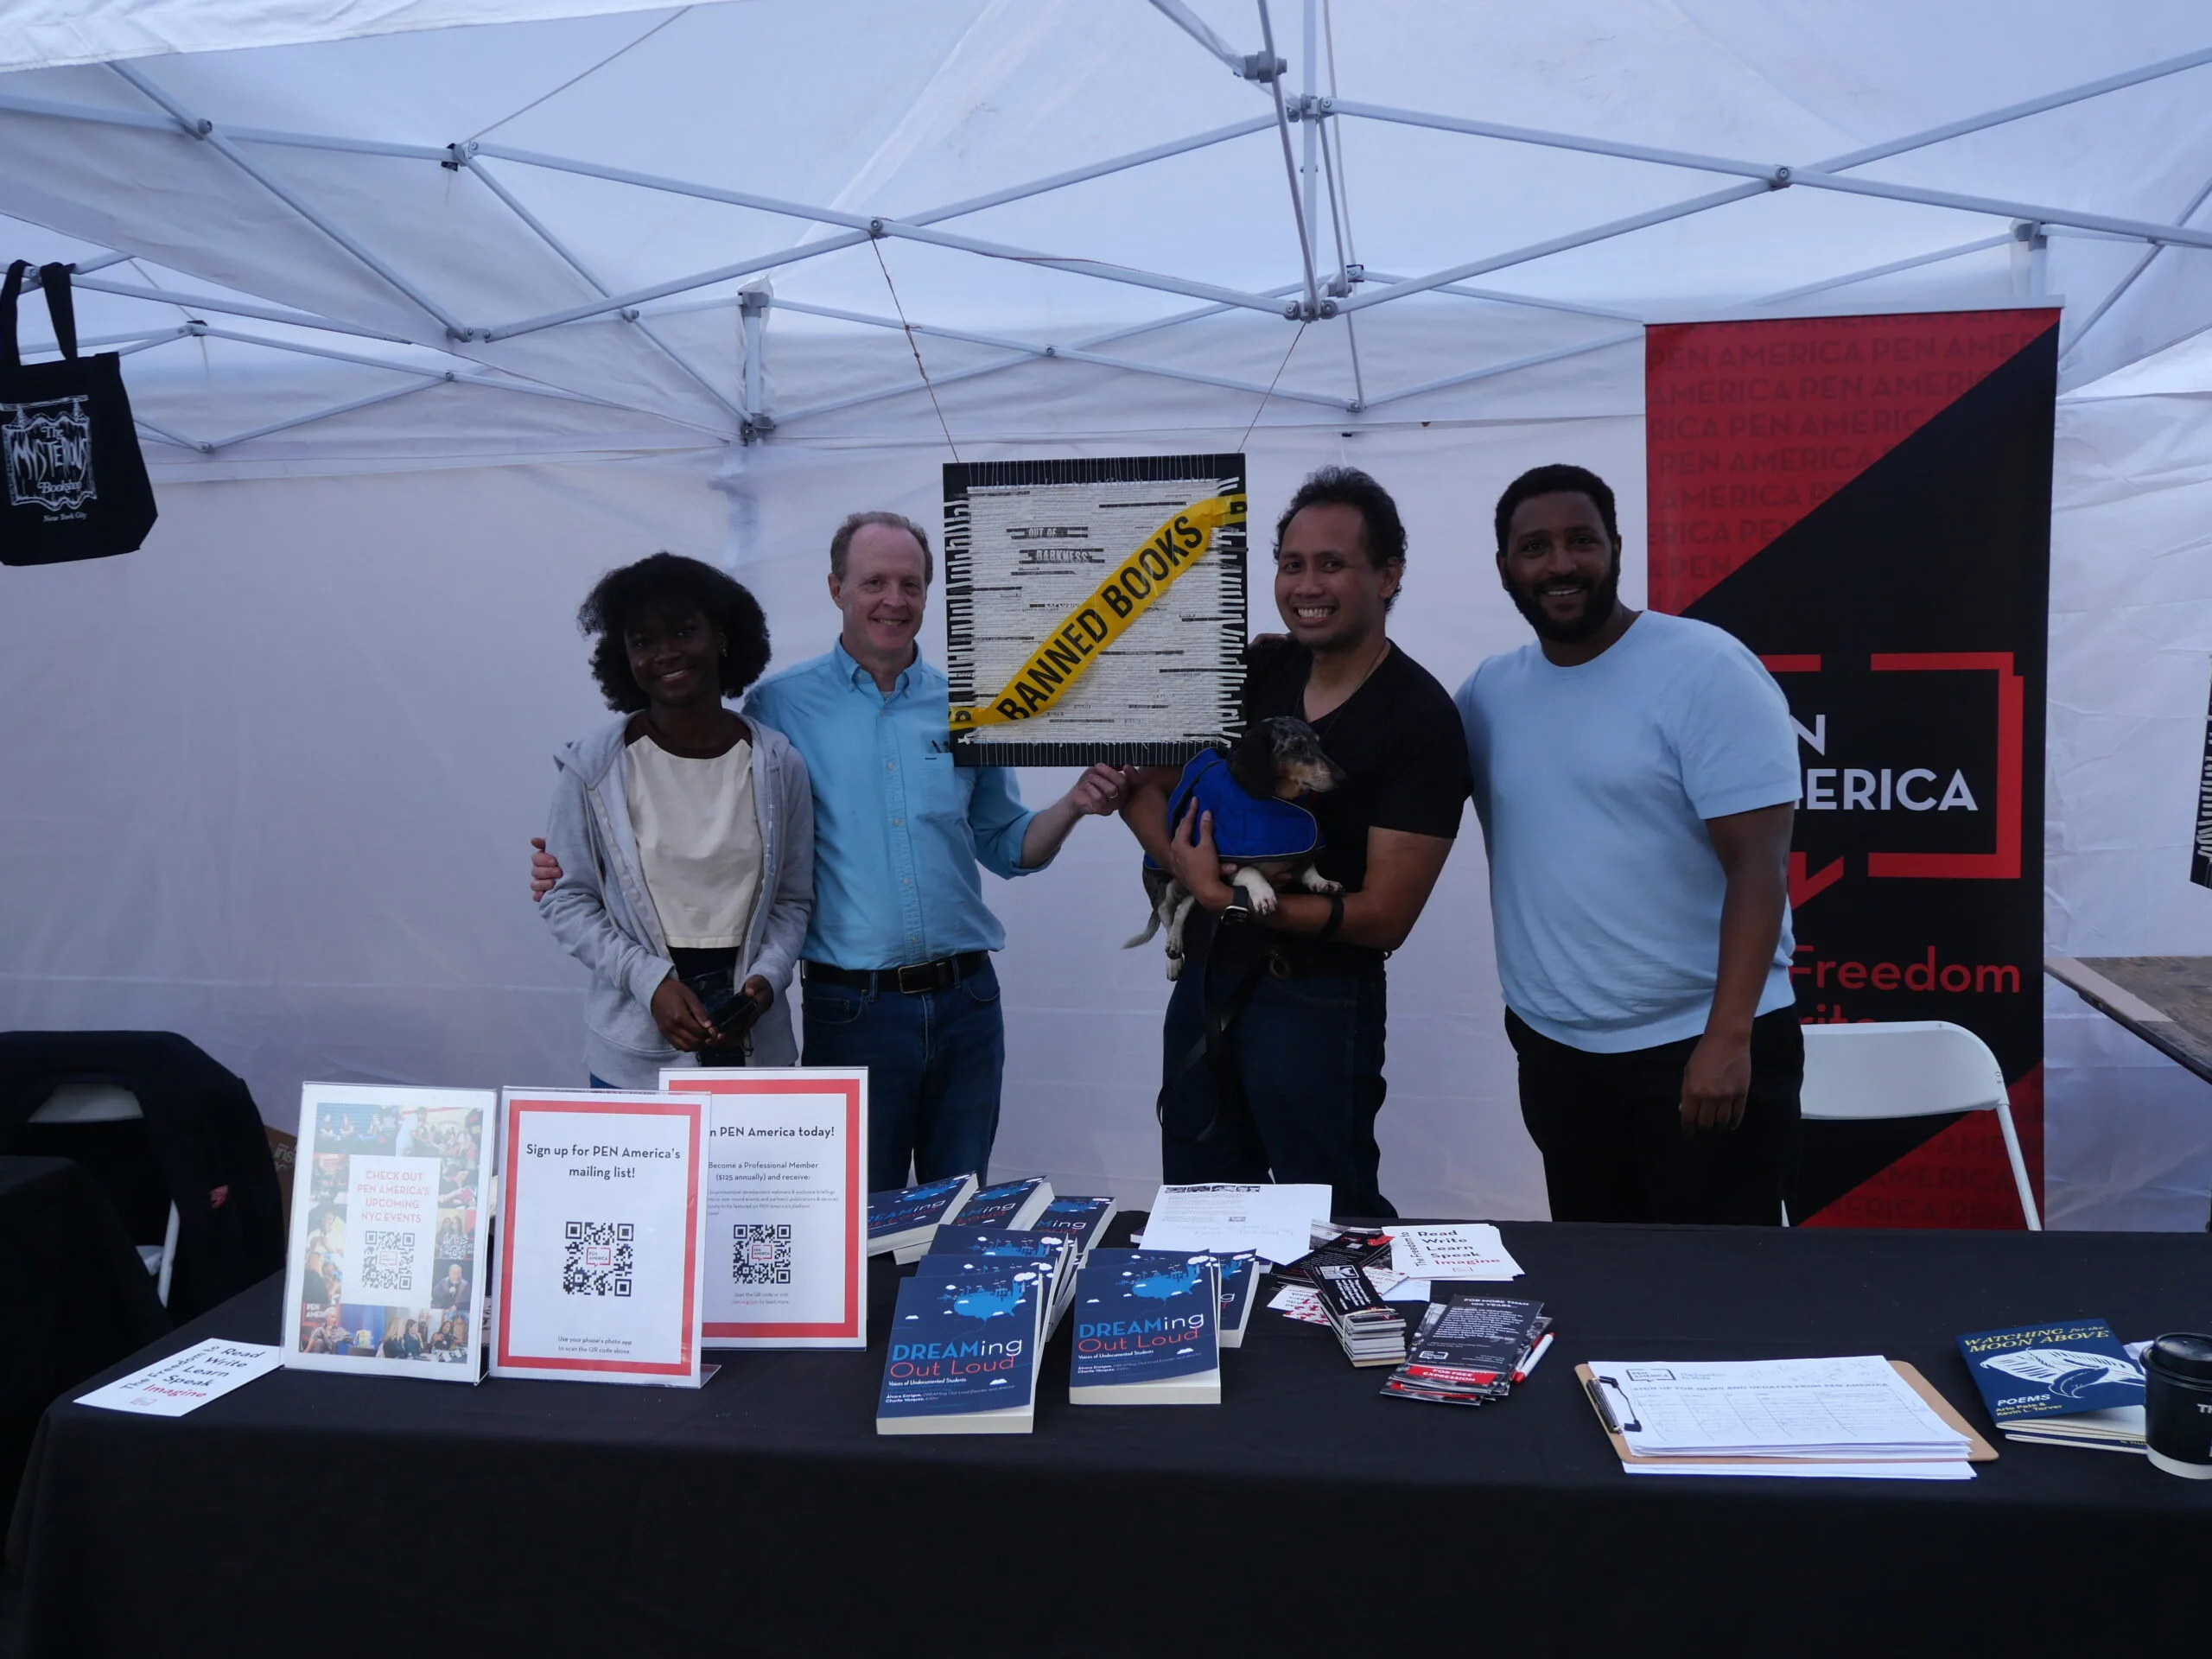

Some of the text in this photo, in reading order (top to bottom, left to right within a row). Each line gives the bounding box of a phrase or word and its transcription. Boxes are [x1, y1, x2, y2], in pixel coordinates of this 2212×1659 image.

[1648, 346, 1709, 372] PEN
[1718, 340, 1861, 370] AMERICA
[1872, 335, 1936, 363] PEN
[1649, 378, 1791, 407] AMERICA
[1800, 373, 1864, 401] PEN
[1730, 411, 1792, 438] PEN
[1799, 407, 1930, 435] AMERIC
[41, 426, 63, 440] The
[1660, 445, 1876, 475] PEN AMERICA
[1660, 483, 1802, 510] AMERICA
[1028, 527, 1057, 537] OUT OF
[1037, 550, 1089, 563] DARKNESS
[996, 515, 1203, 721] BANNED BOOKS
[1799, 768, 1979, 811] ERICA
[720, 1126, 745, 1137] PEN
[747, 1126, 796, 1137] America
[798, 1126, 835, 1139] today!
[525, 1143, 681, 1159] Sign up for PEN America's
[365, 1170, 423, 1181] CHECK OUT
[569, 1165, 635, 1180] mailing list!
[734, 1173, 766, 1181] annually)
[358, 1183, 430, 1196] PEN AMERICA'S
[365, 1198, 420, 1209] UPCOMING
[361, 1211, 422, 1224] NYC EVENTS
[1037, 1219, 1087, 1230] Ming
[1079, 1313, 1205, 1338] DREAMing
[1077, 1325, 1199, 1352] Out Loud
[1964, 1328, 2064, 1347] WATCHING
[1970, 1330, 2110, 1353] MOON ABOVE
[220, 1347, 267, 1359] Read
[892, 1339, 1023, 1362] DREAMing
[204, 1357, 249, 1369] Write
[890, 1351, 1015, 1378] Out Loud
[120, 1376, 150, 1390] The
[148, 1351, 207, 1378] Freedom
[182, 1365, 230, 1377] Learn
[1422, 1371, 1476, 1382] EXPRESSION
[163, 1375, 214, 1387] Speak
[143, 1384, 207, 1397] Imagine
[1997, 1394, 2051, 1407] POEMS
